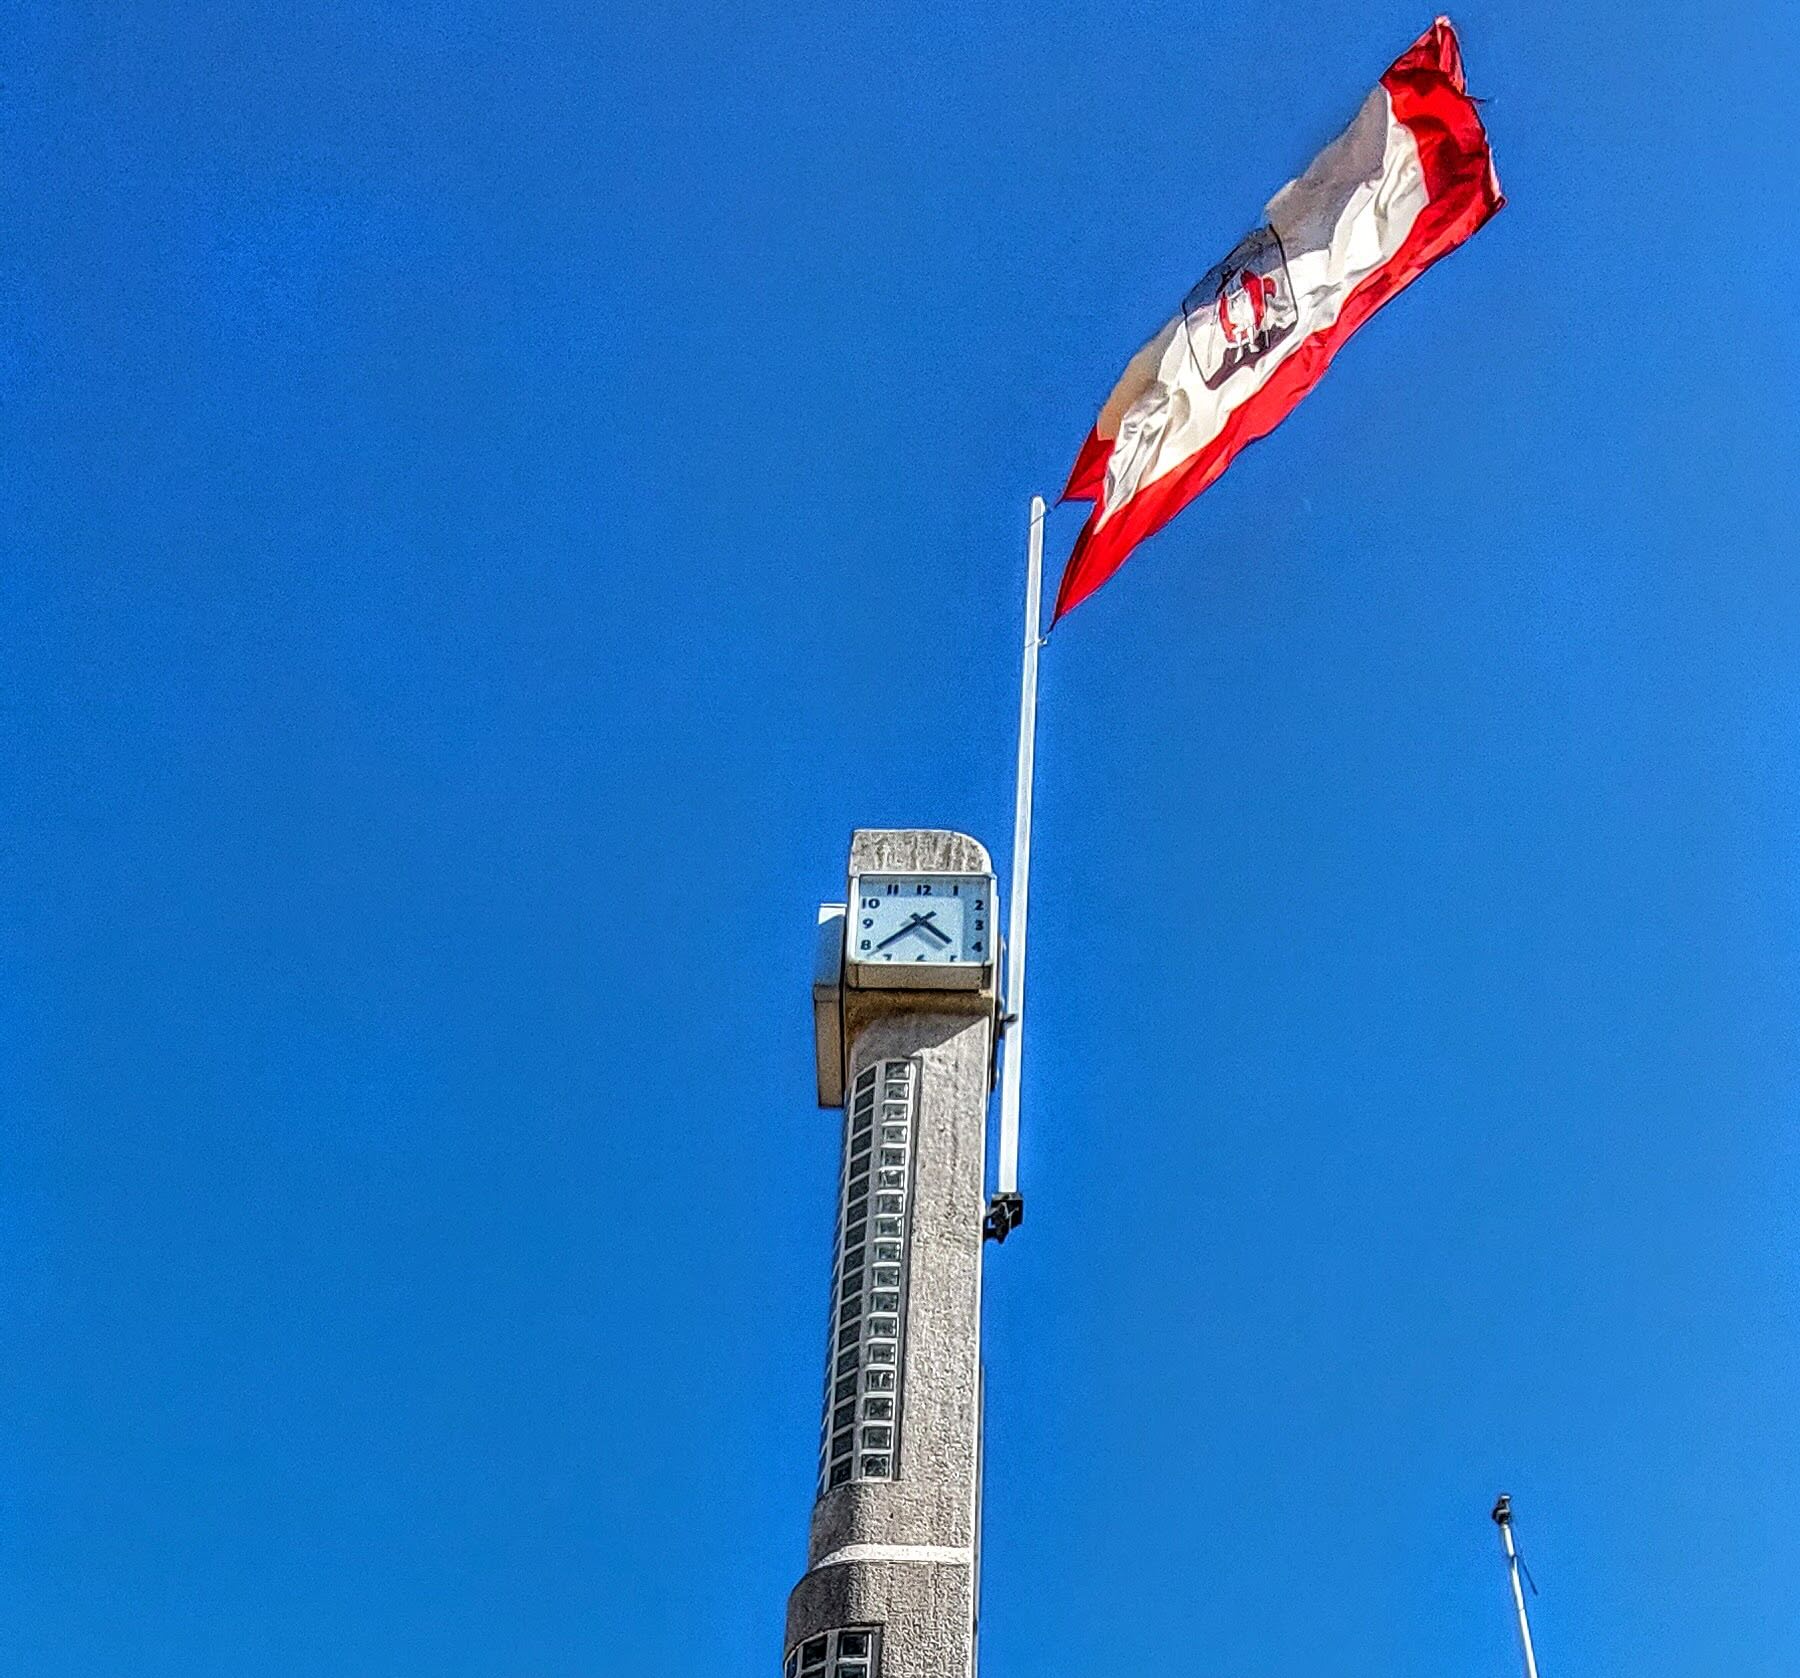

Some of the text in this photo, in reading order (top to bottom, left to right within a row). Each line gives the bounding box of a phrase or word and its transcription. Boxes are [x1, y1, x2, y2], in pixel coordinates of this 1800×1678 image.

[887, 884, 899, 896] 11
[916, 884, 932, 896] 12
[953, 885, 958, 896] 1
[862, 898, 880, 909] 10
[975, 900, 984, 911] 2
[862, 918, 874, 929] 9
[975, 919, 984, 931] 3
[860, 939, 872, 951] 8
[971, 942, 983, 952] 4
